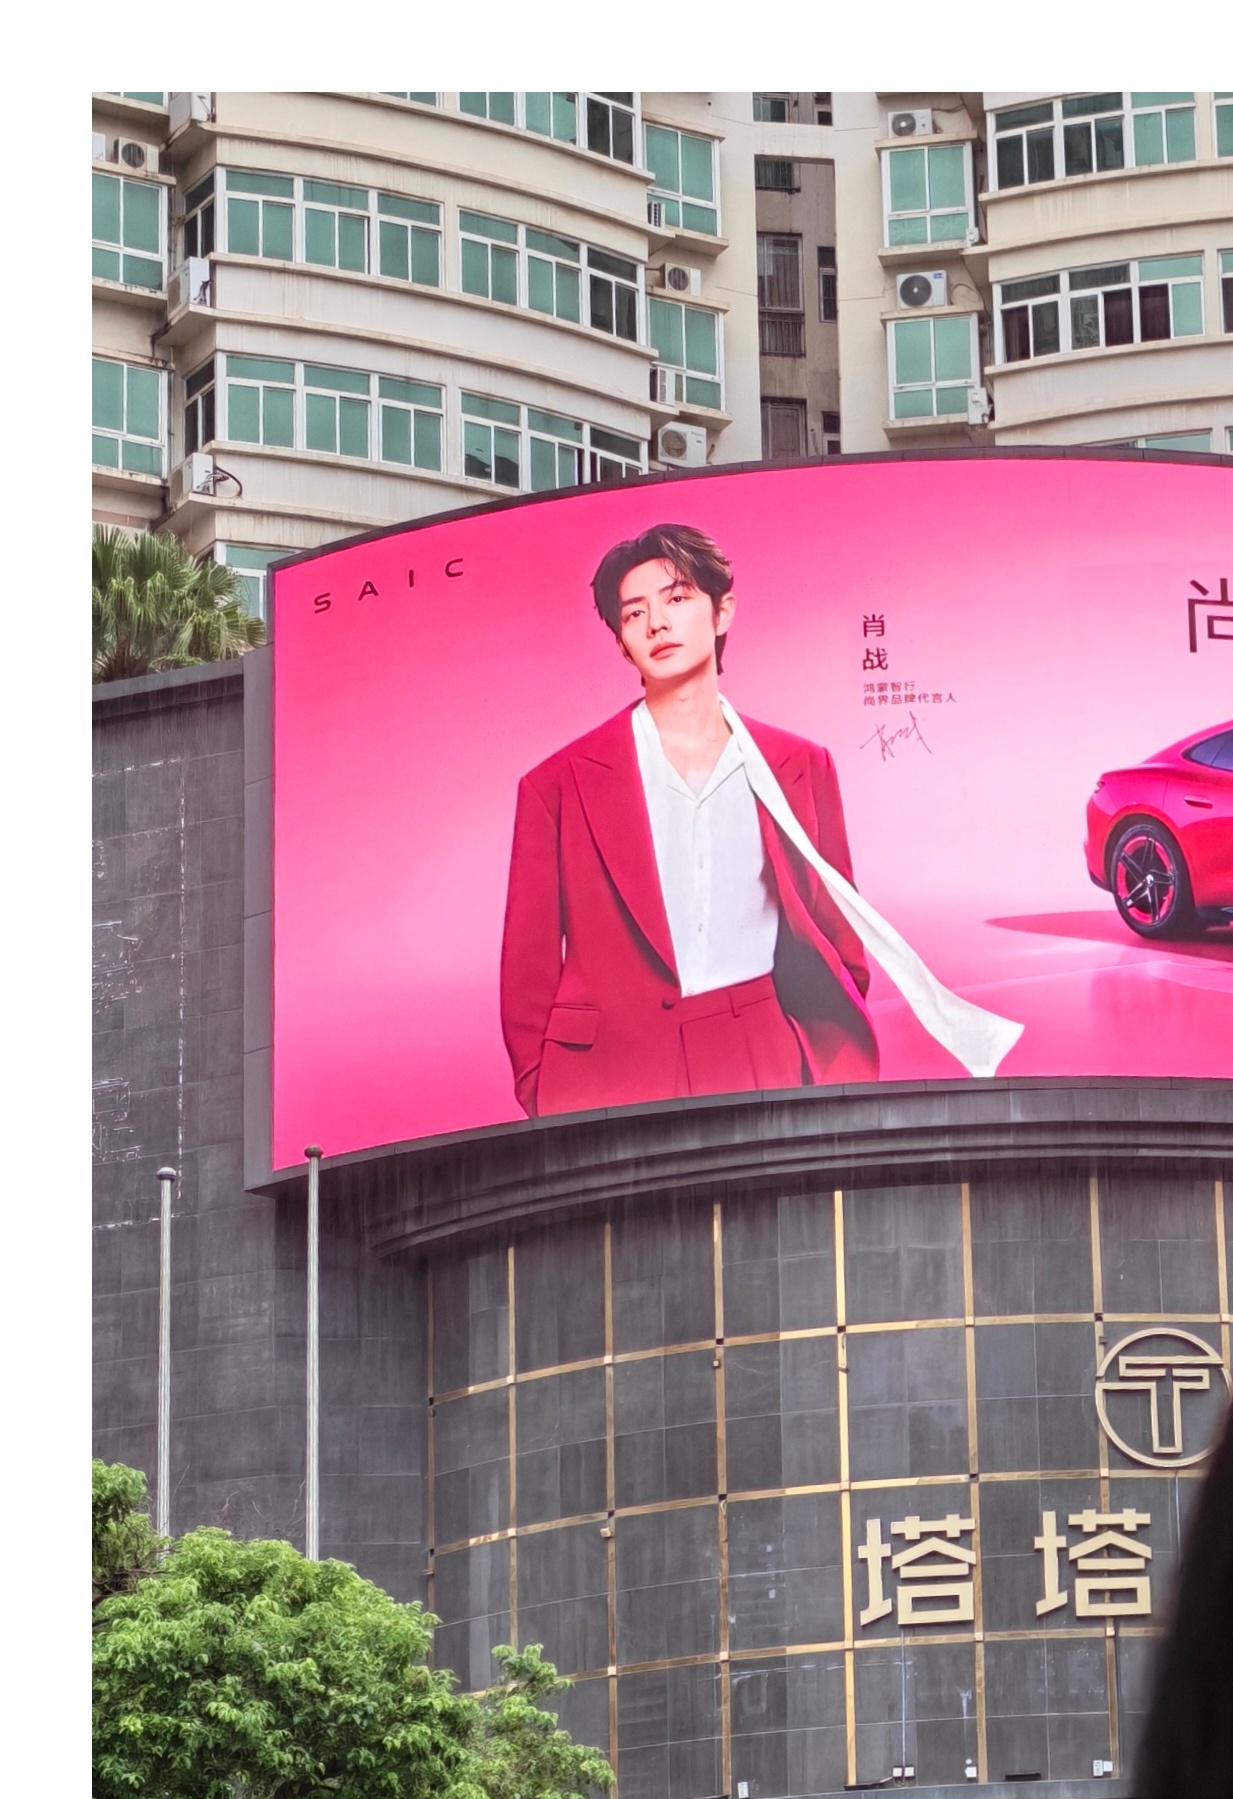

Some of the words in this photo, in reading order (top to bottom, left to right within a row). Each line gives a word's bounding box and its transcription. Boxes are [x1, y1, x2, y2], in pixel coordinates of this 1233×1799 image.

[313, 557, 464, 614] SAIC
[862, 613, 889, 671] 肖战
[863, 680, 916, 694] 鸿蒙智行
[863, 692, 957, 707] 尚界品牌代言人
